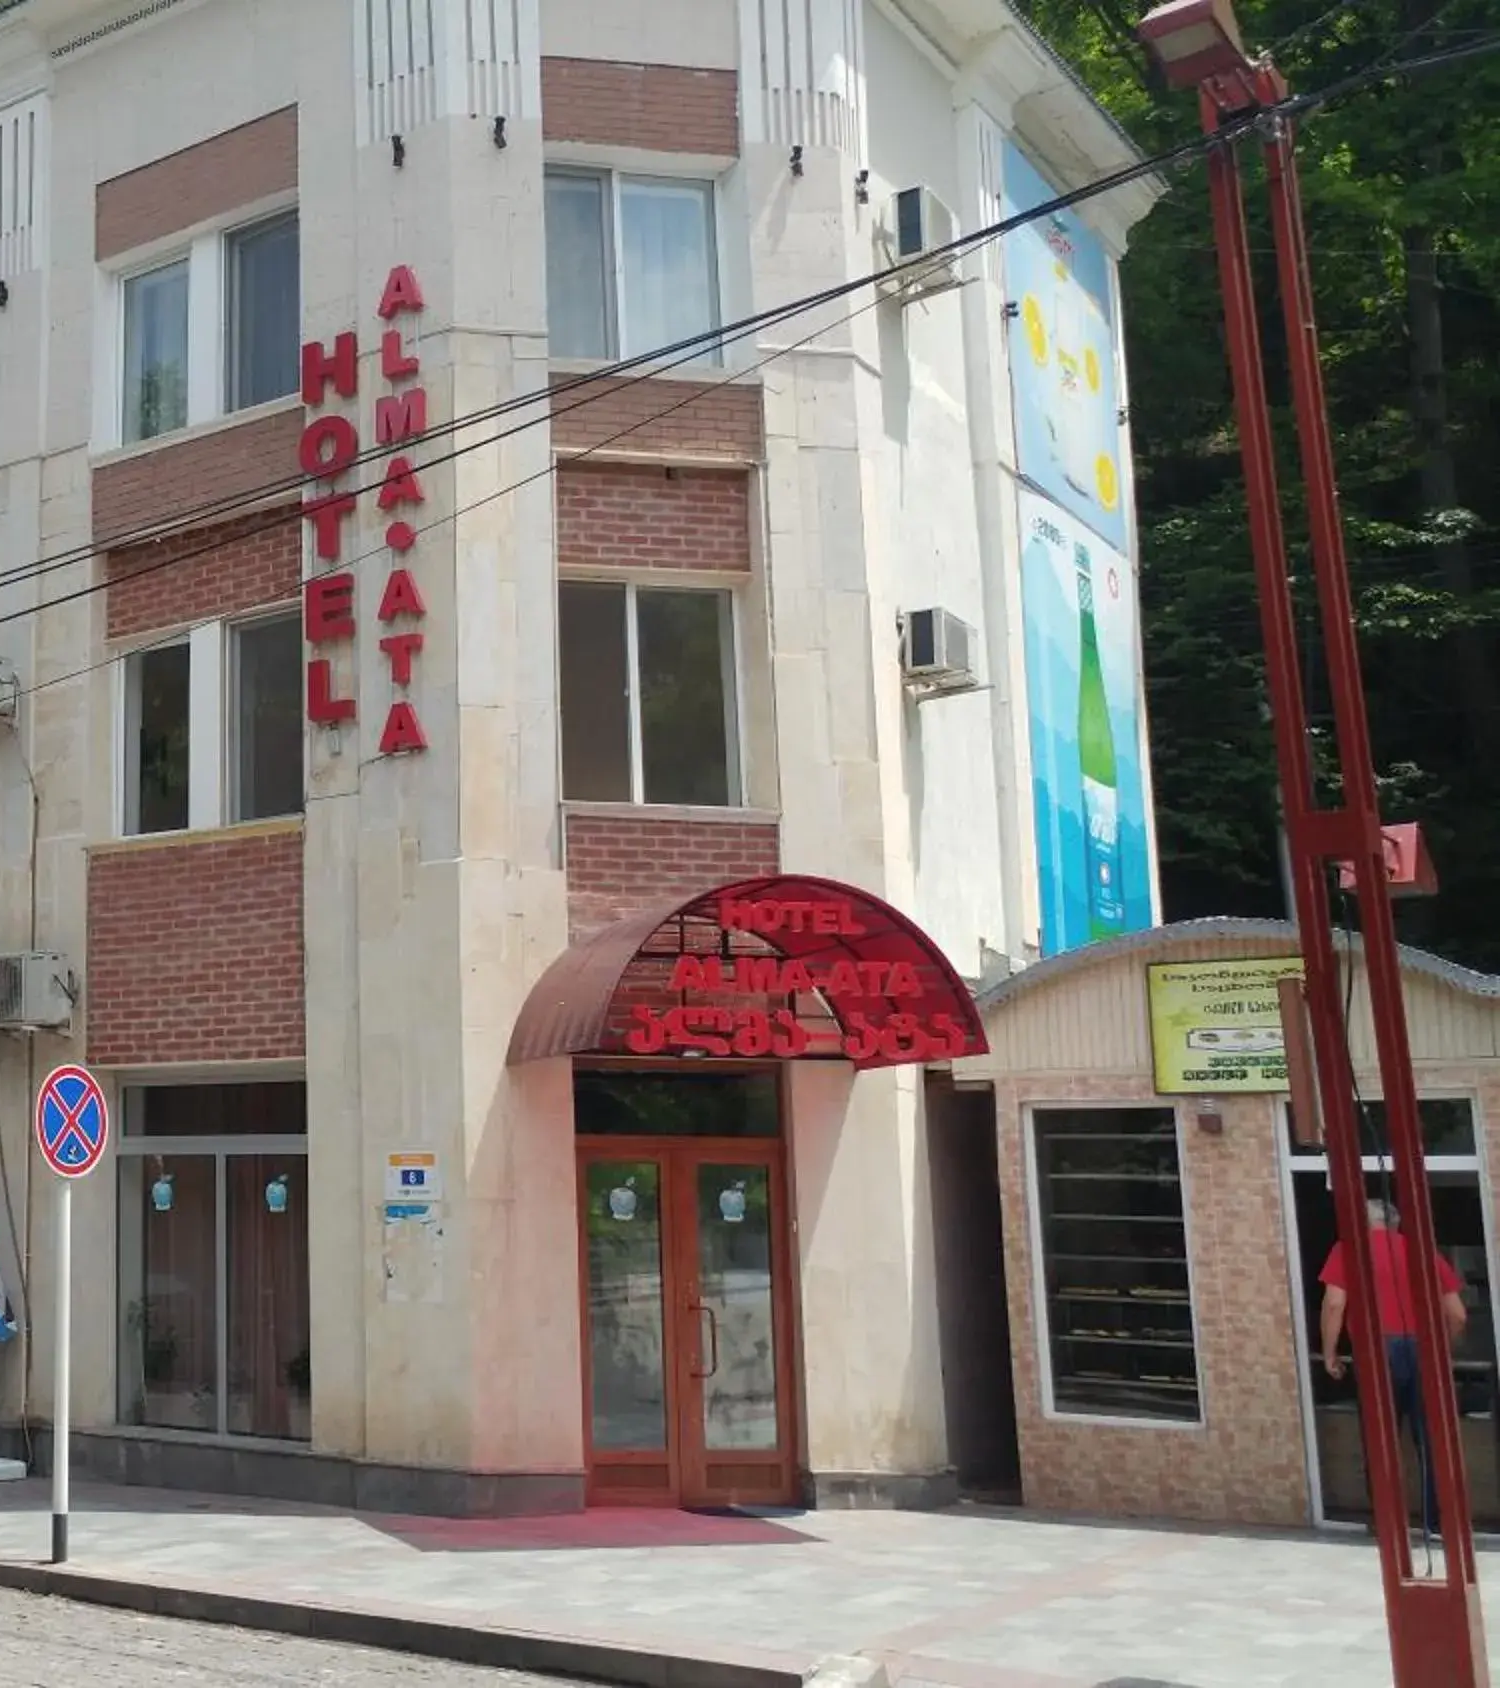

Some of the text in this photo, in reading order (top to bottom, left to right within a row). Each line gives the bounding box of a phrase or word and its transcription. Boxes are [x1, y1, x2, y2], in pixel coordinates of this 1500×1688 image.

[299, 330, 359, 725] HOTEL
[718, 897, 867, 935] HOTEL
[666, 955, 923, 998] ALMA-ATA
